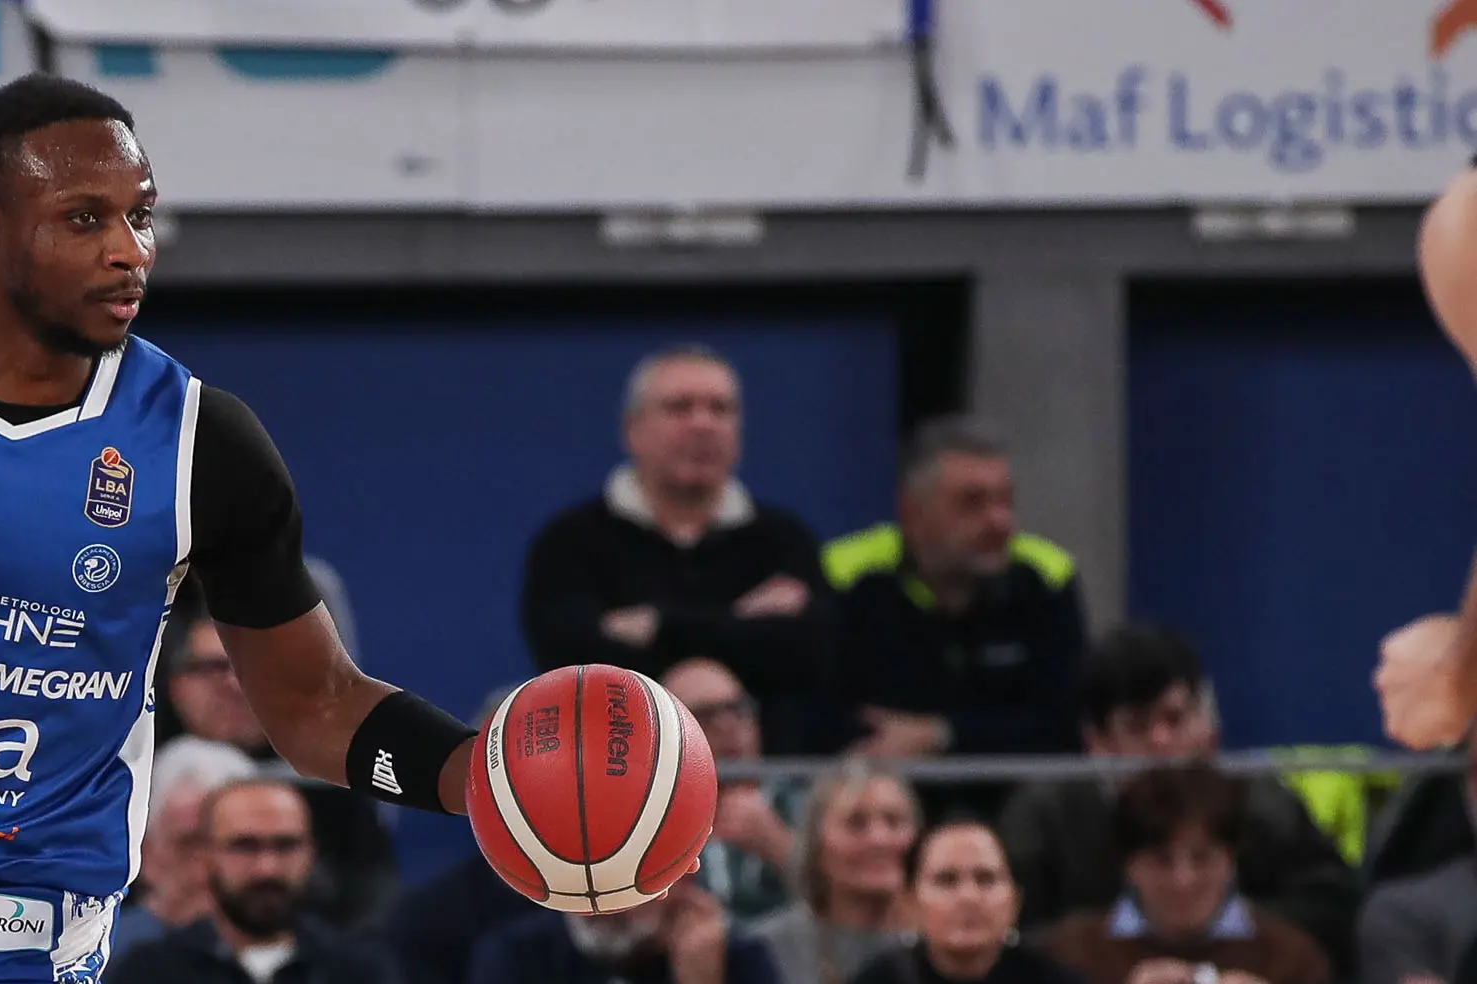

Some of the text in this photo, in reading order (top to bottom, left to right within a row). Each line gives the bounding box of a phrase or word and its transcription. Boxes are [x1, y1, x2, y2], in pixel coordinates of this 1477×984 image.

[977, 65, 1146, 150] Maf
[95, 478, 127, 496] LBA
[536, 705, 560, 753] FIBA
[606, 683, 636, 777] molten
